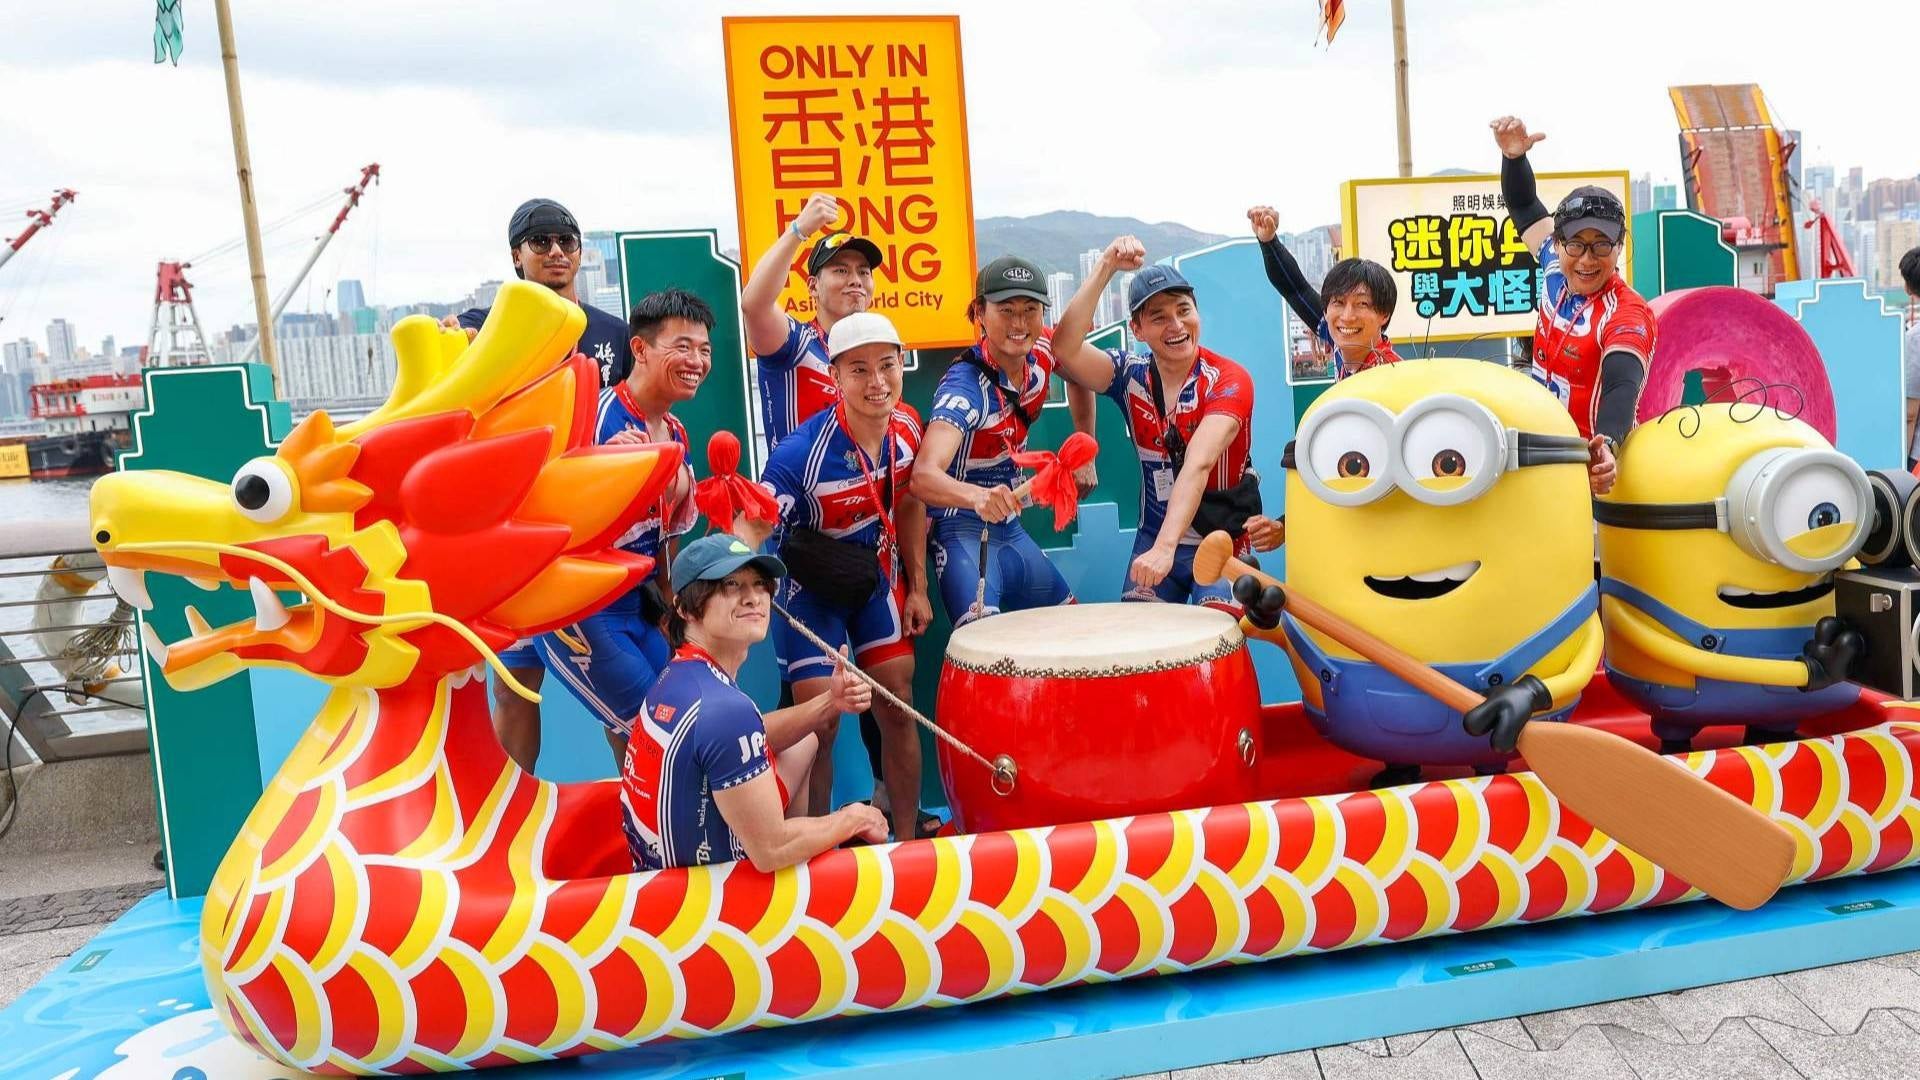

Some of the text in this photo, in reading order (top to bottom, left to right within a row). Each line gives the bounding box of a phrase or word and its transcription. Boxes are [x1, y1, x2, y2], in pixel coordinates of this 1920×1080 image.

[760, 44, 928, 80] ONLY IN
[762, 86, 936, 189] 香港
[784, 243, 942, 289] KNG
[903, 291, 943, 315] City
[697, 798, 709, 827] racing
